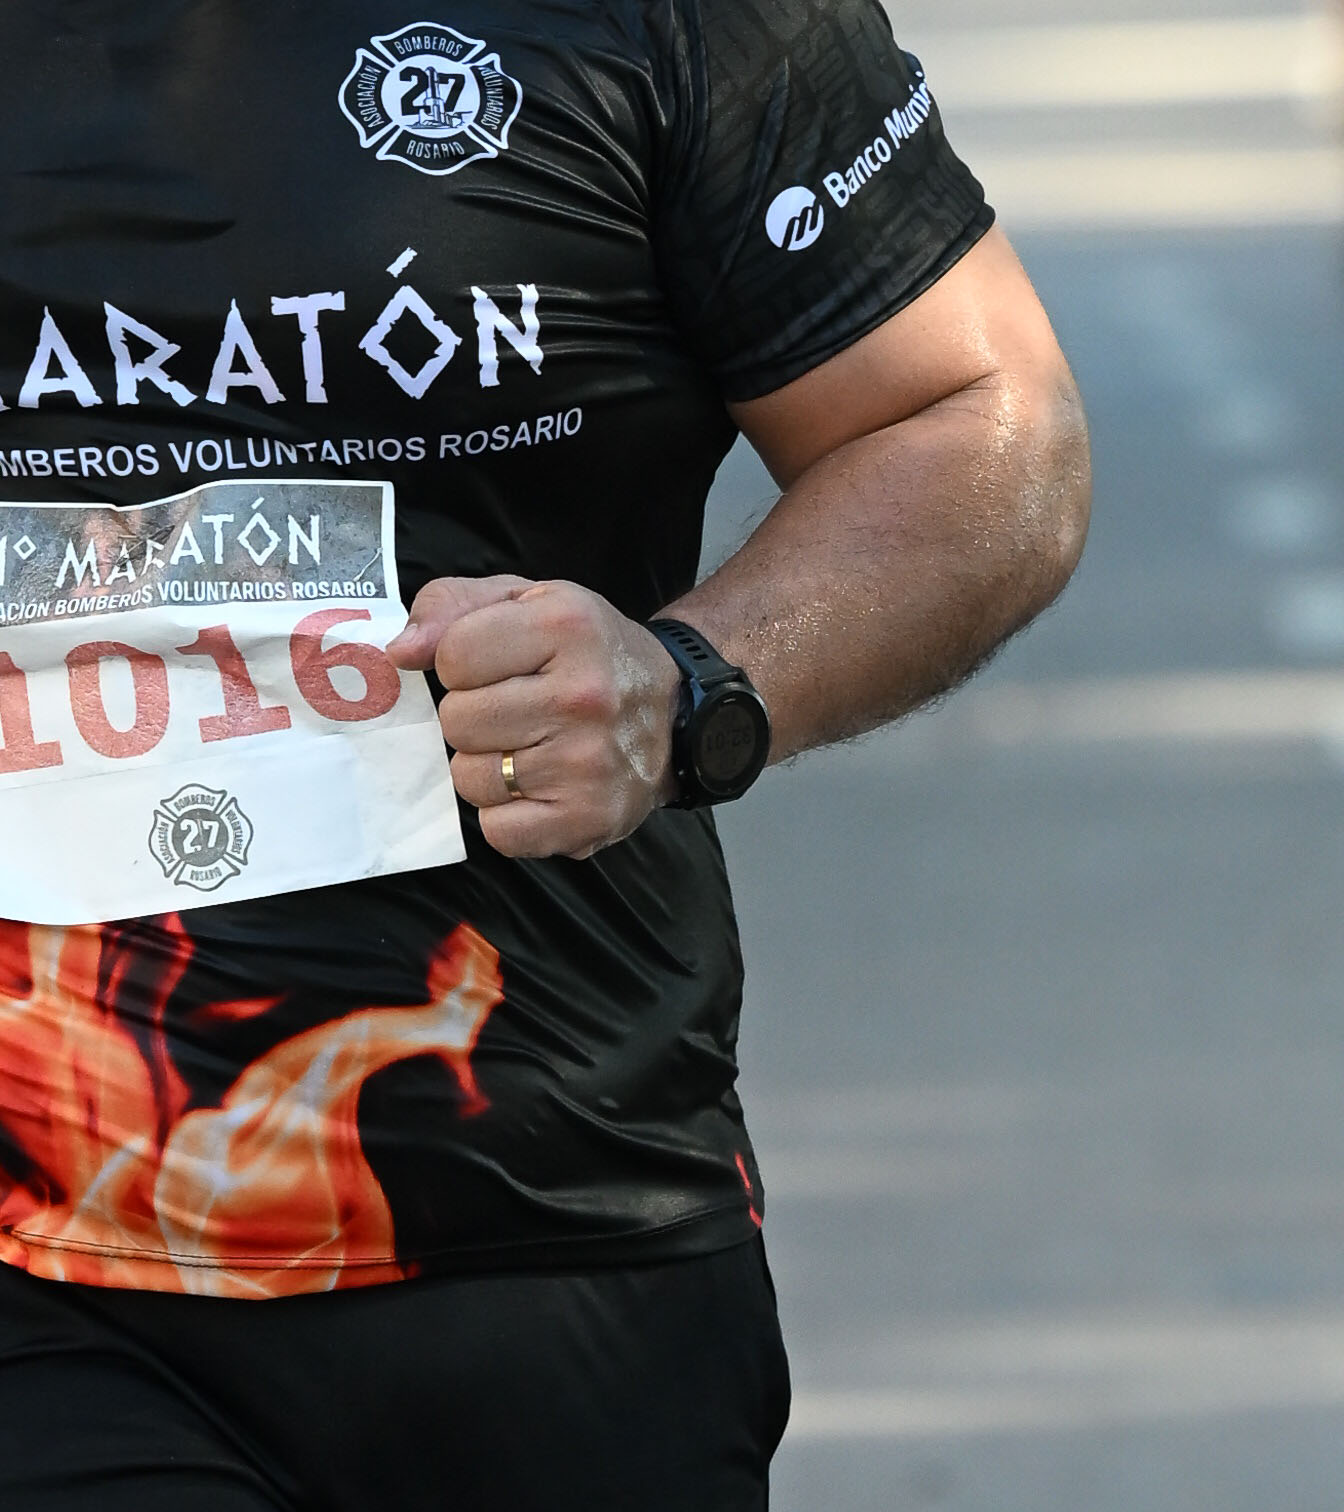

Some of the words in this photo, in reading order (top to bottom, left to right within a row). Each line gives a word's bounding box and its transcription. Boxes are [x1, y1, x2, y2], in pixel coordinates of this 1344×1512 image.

[394, 35, 463, 57] BOMBEROS
[399, 66, 466, 116] 27
[406, 139, 465, 160] ROSARIO
[822, 136, 892, 208] Banco
[168, 436, 426, 474] VOLUNTARIOS
[439, 407, 584, 460] ROSARIO
[54, 584, 154, 616] BOMBEROS
[157, 580, 286, 602] VOLUNTARIOS
[292, 577, 377, 598] ROSARIO
[180, 818, 220, 854] 27
